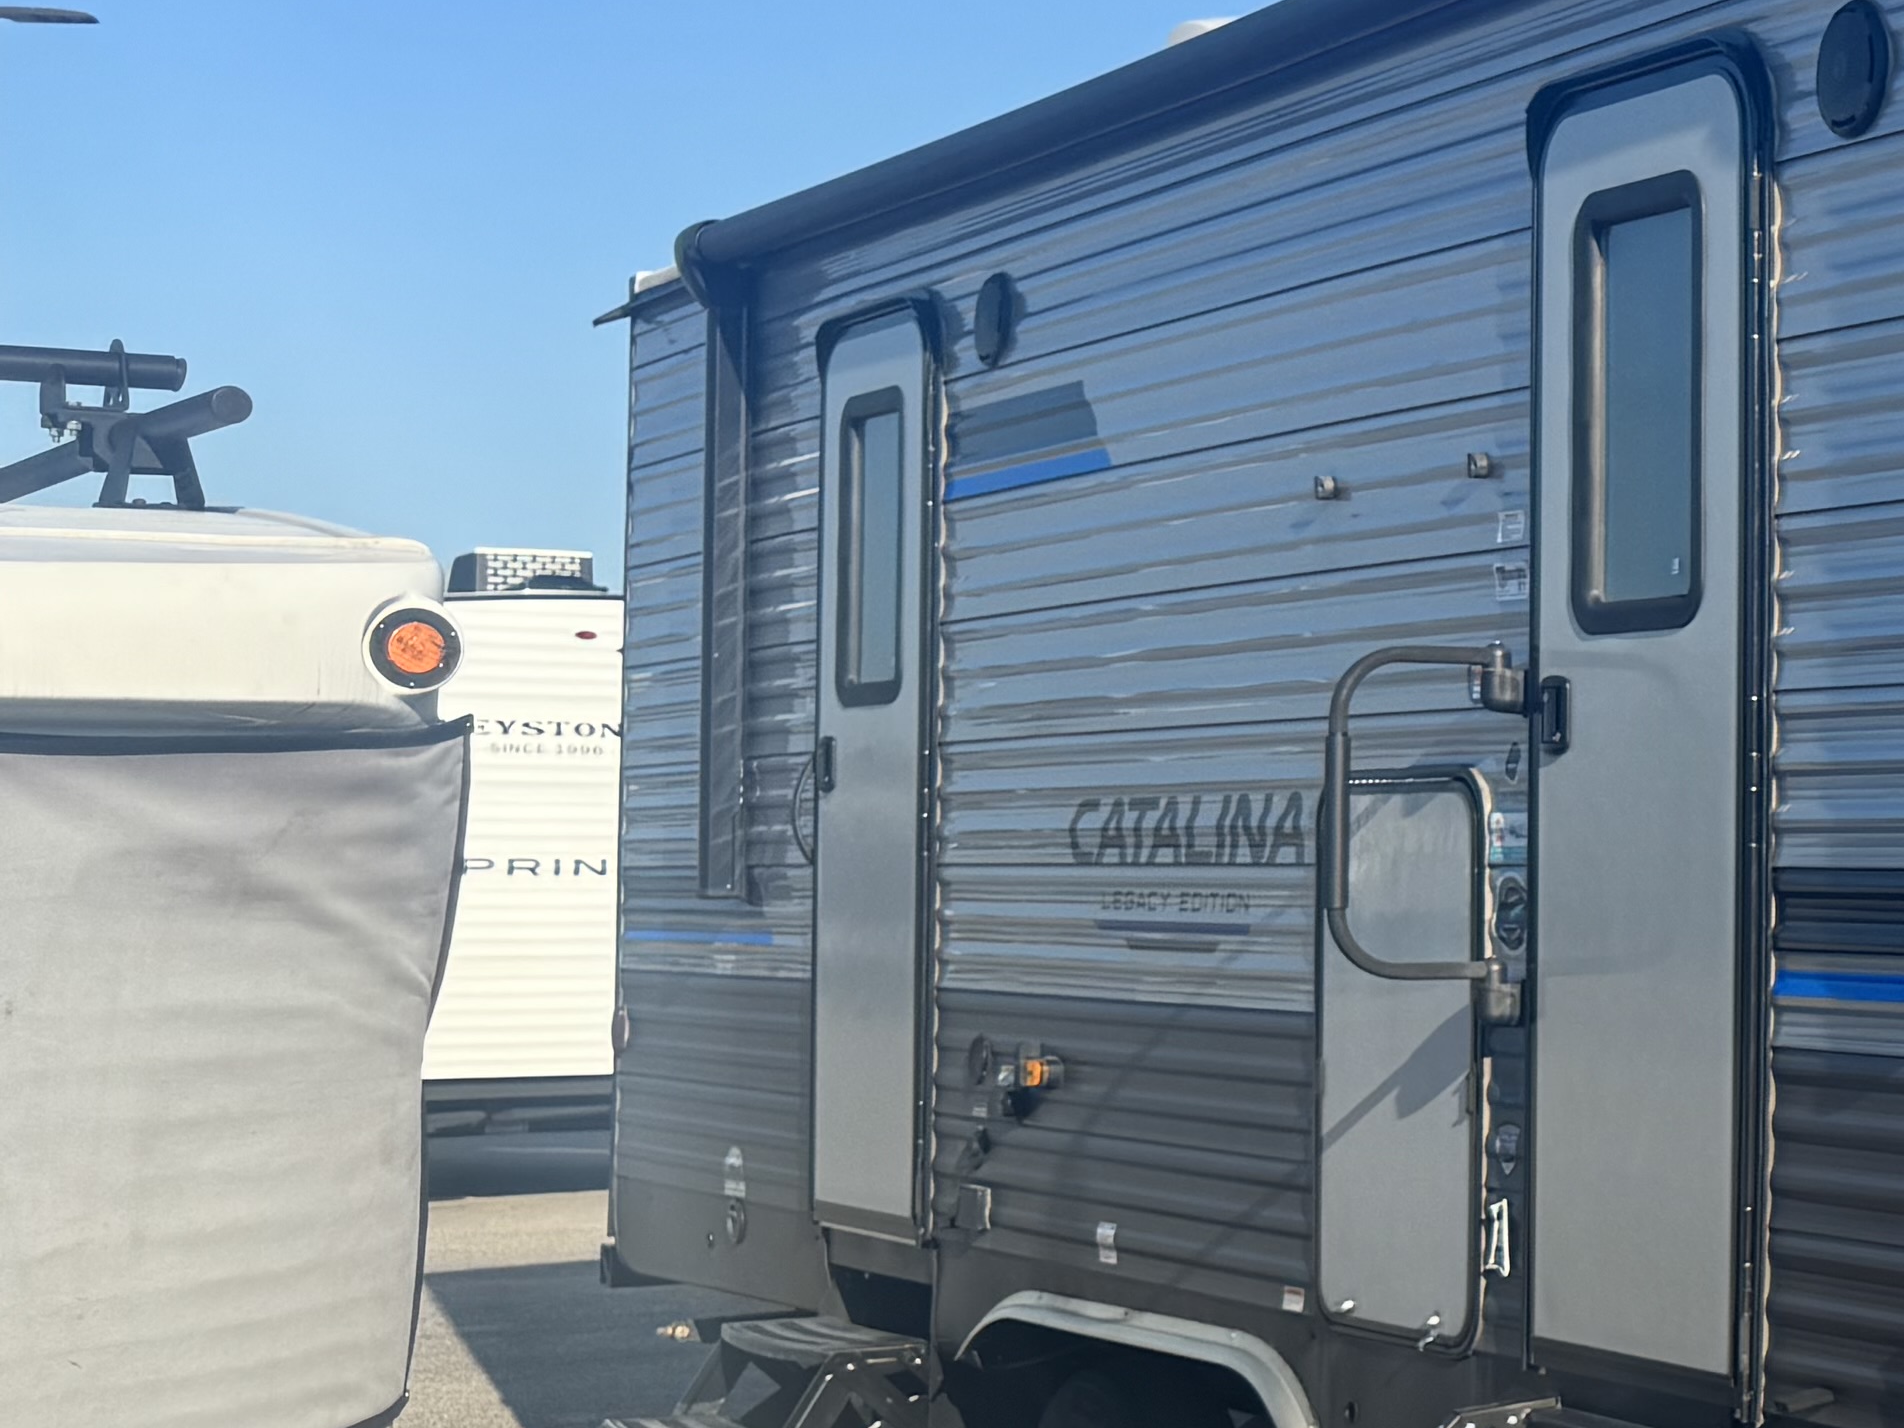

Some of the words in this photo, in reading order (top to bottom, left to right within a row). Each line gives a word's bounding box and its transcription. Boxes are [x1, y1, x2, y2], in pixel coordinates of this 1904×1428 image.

[1068, 790, 1306, 864] CATALINA
[1100, 890, 1171, 912] LEGACY
[1178, 891, 1252, 914] EDITION
